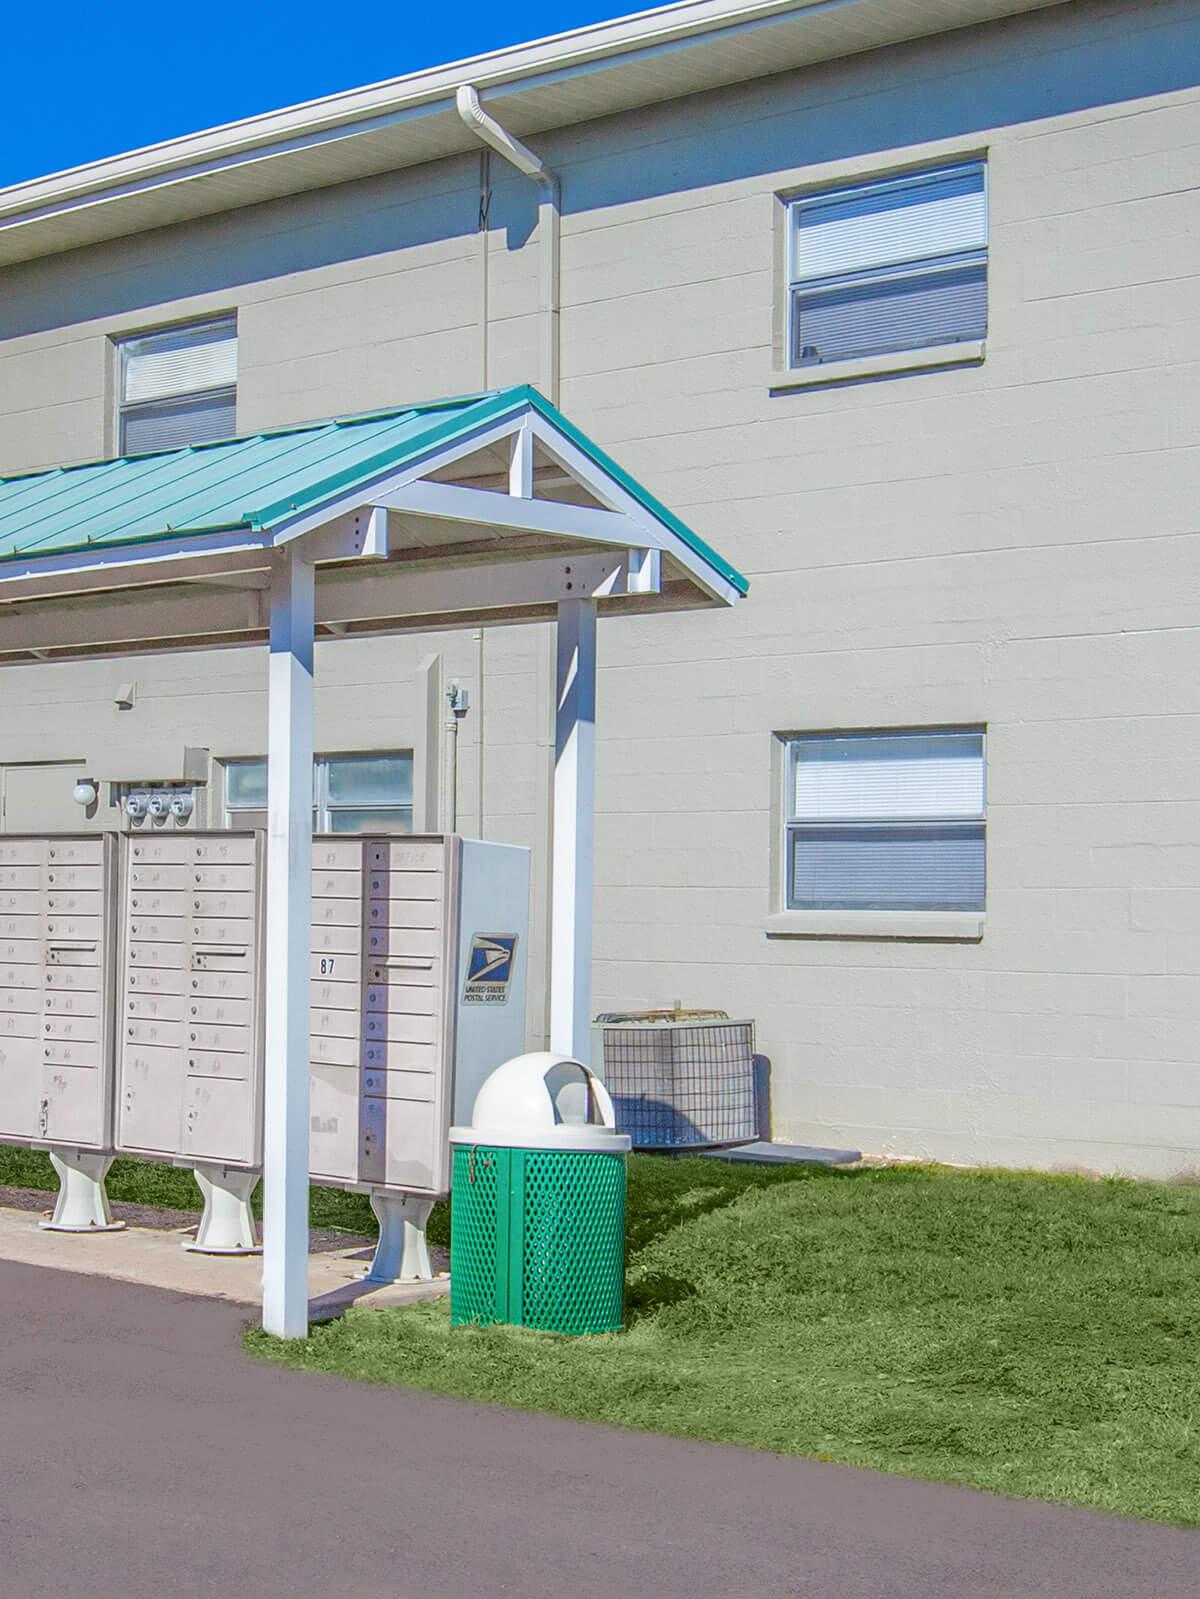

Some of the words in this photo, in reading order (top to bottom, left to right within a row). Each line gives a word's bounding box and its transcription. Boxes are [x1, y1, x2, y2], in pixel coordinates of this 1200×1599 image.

[320, 958, 335, 975] 87
[465, 985, 486, 993] UNITED
[487, 985, 505, 994] STATES
[464, 994, 484, 1002] POSTAL
[485, 994, 506, 1002] SERVICE
